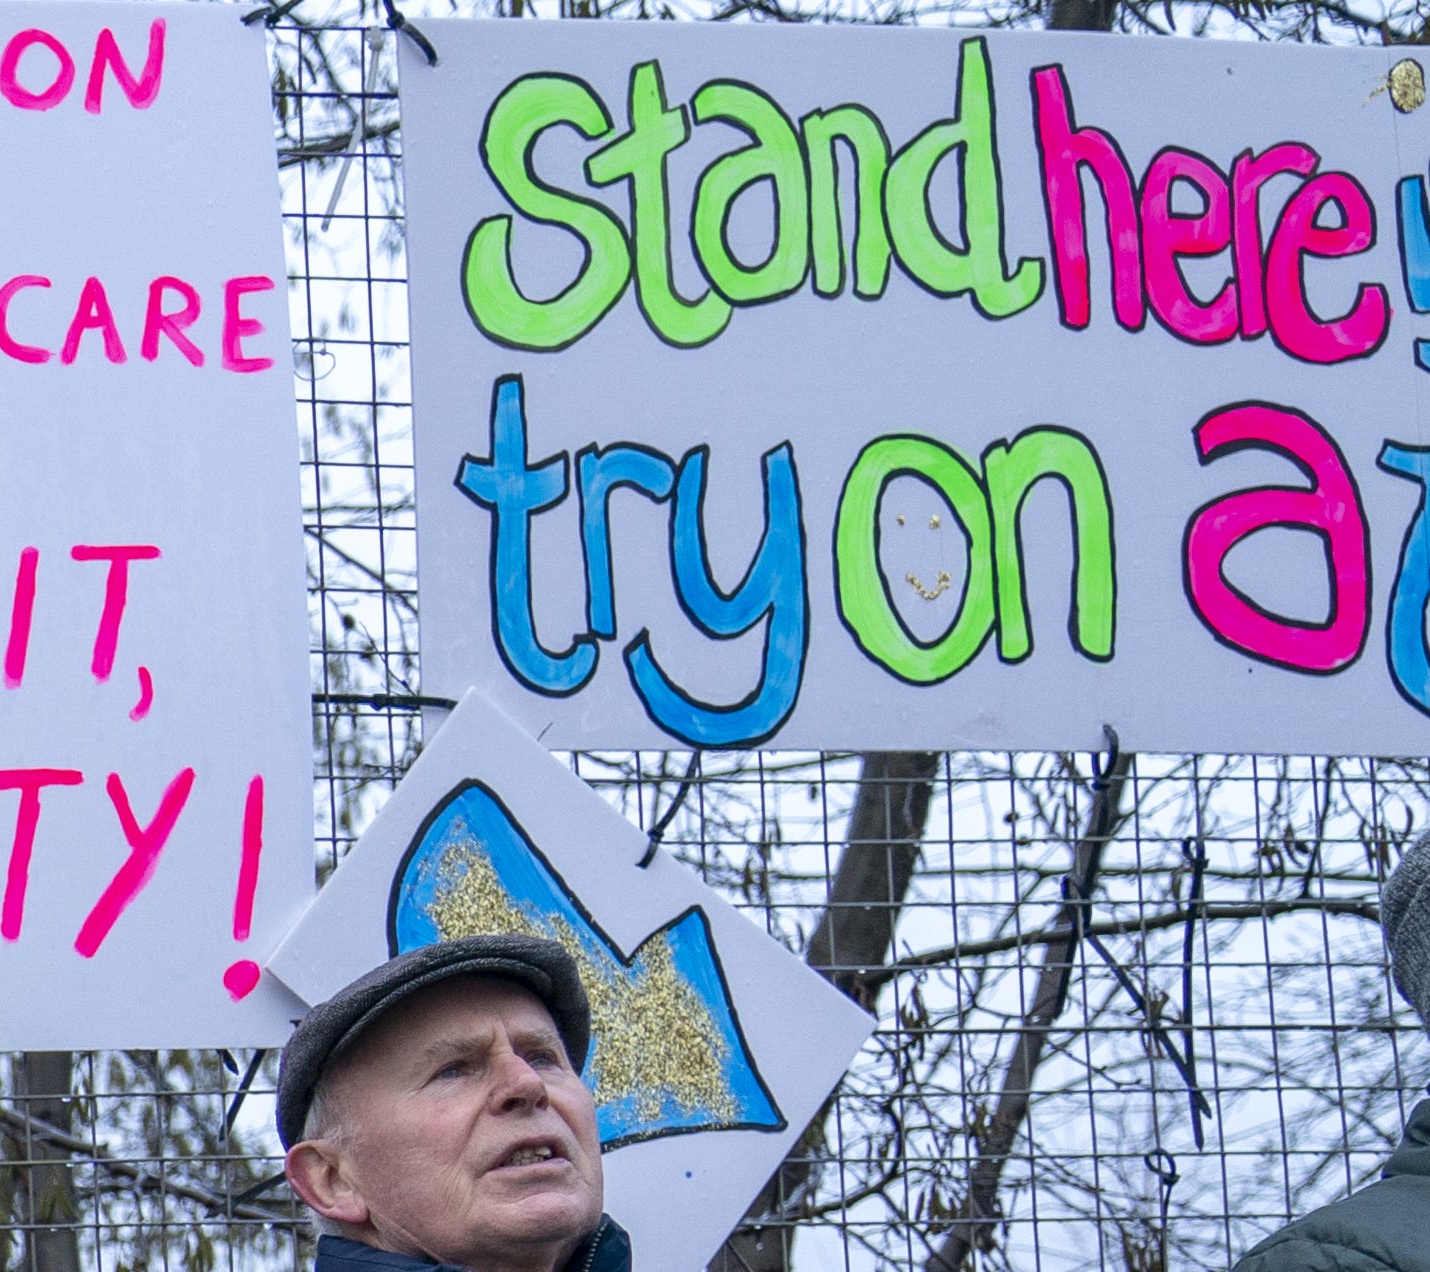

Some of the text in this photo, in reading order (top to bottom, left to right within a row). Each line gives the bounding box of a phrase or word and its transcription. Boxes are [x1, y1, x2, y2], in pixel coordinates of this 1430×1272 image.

[1029, 63, 1393, 365] here
[2, 543, 162, 722] IT,
[453, 372, 810, 750] try
[832, 424, 1116, 685] on
[1182, 400, 1370, 677] a
